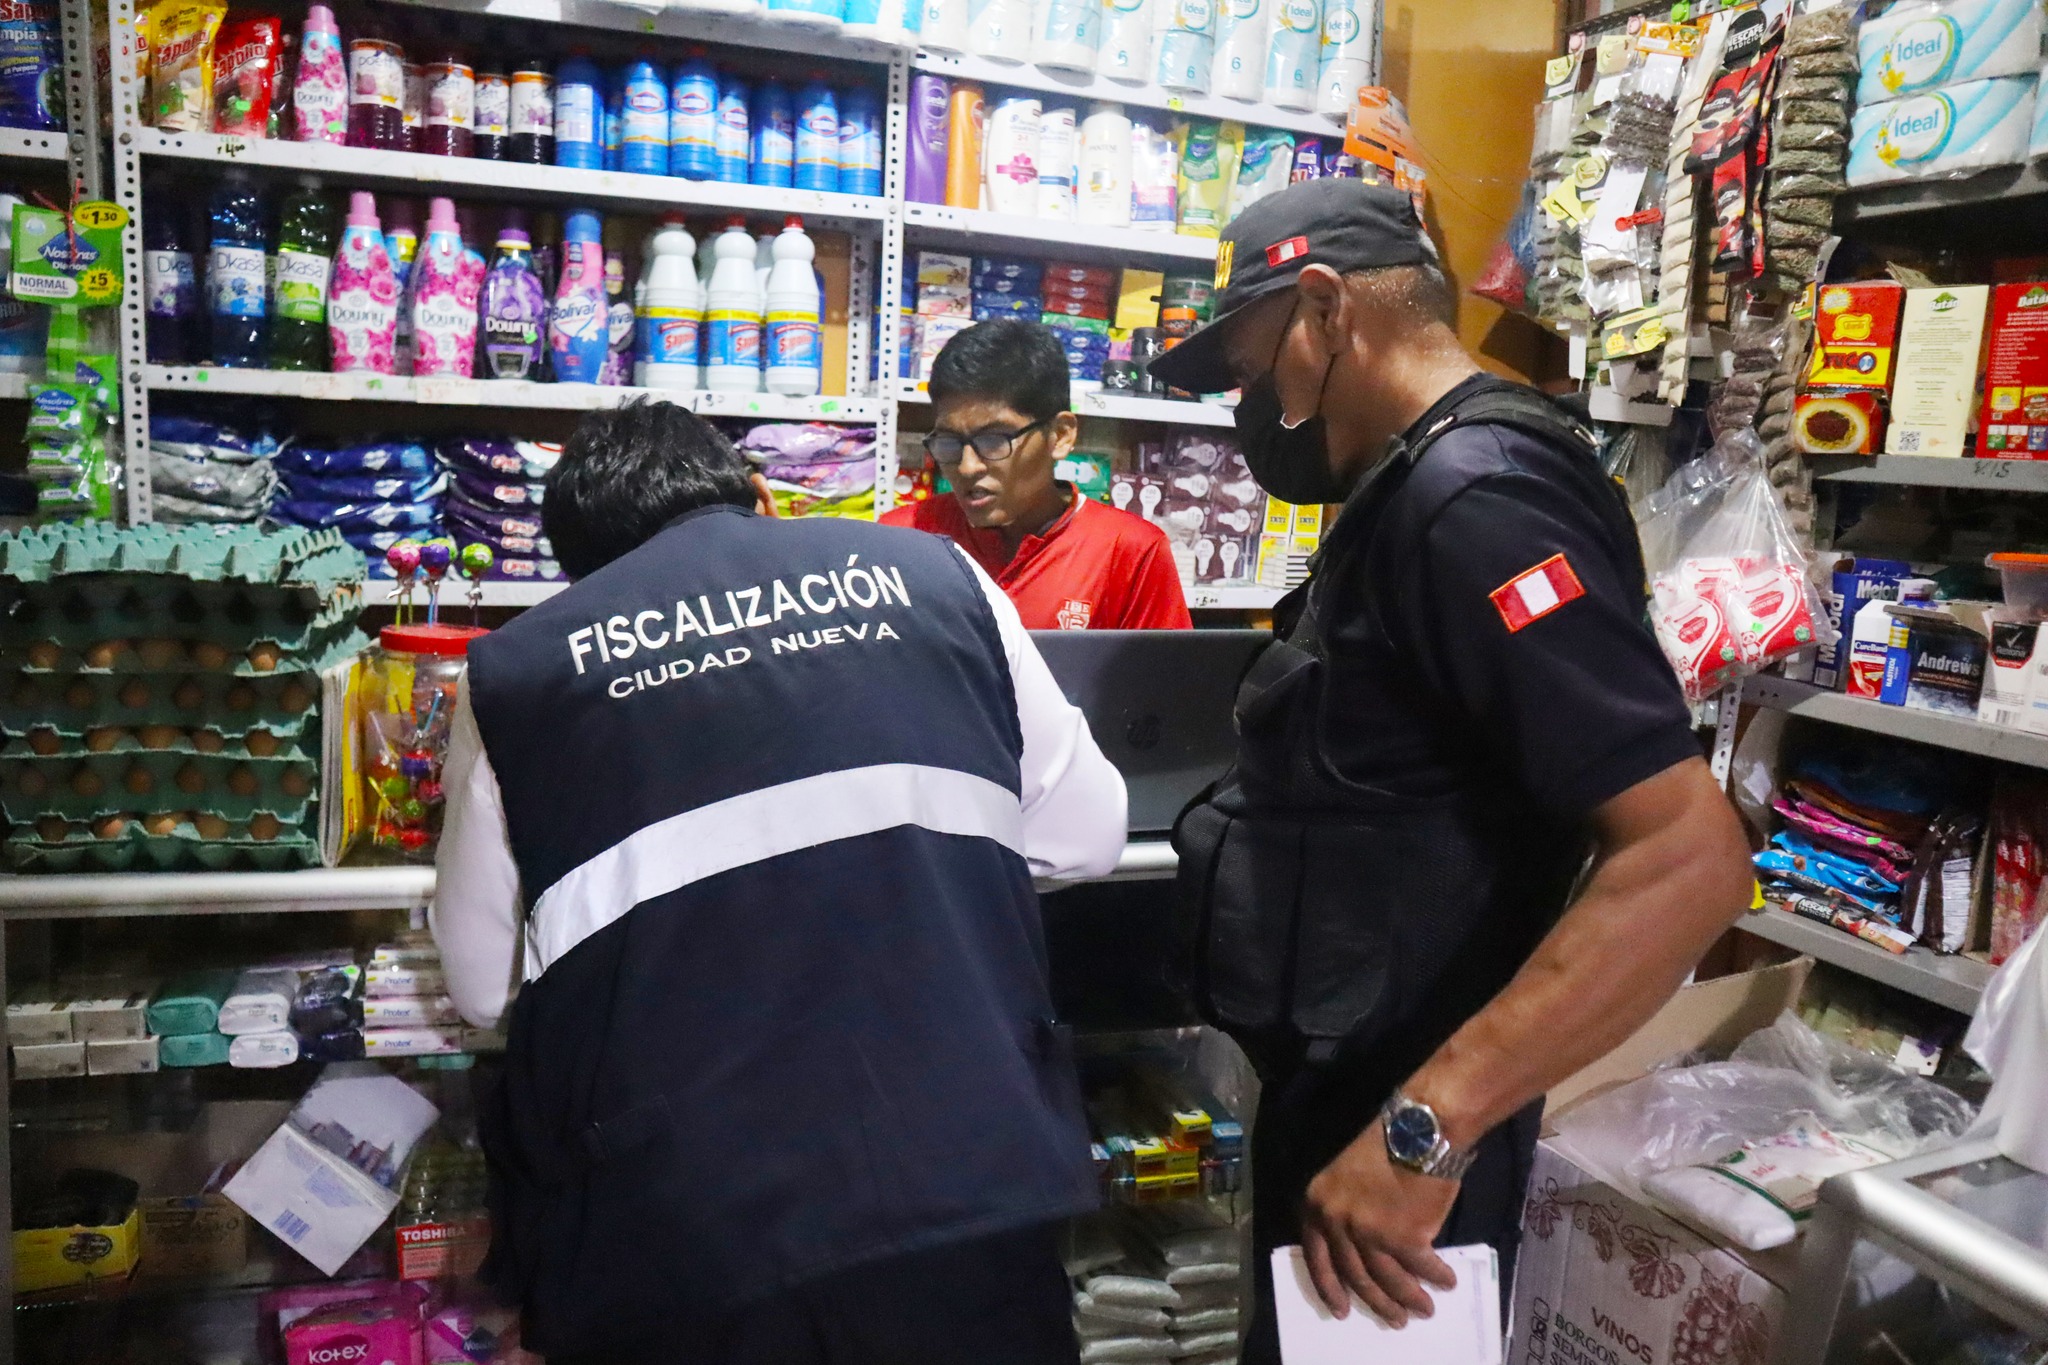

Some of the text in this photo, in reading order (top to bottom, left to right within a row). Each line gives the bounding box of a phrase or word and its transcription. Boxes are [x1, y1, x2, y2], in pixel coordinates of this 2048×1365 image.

[1290, 4, 1313, 18] Ideal
[1897, 32, 1943, 62] Ideal
[1187, 65, 1195, 79] 6
[1231, 57, 1241, 70] 6
[1294, 68, 1303, 82] 6
[1894, 109, 1940, 138] Ideal
[91, 210, 117, 225] 1.30
[43, 246, 97, 260] Nosras
[20, 276, 68, 290] NORMAL
[332, 304, 385, 326] Downy
[422, 309, 470, 331] Downy
[485, 317, 536, 336] Downy
[567, 554, 912, 675] FISCALIZACIÓN
[608, 622, 901, 699] CIUDAD NUEVA
[1918, 652, 1980, 676] Andrews
[1591, 1306, 1653, 1365] VINOS
